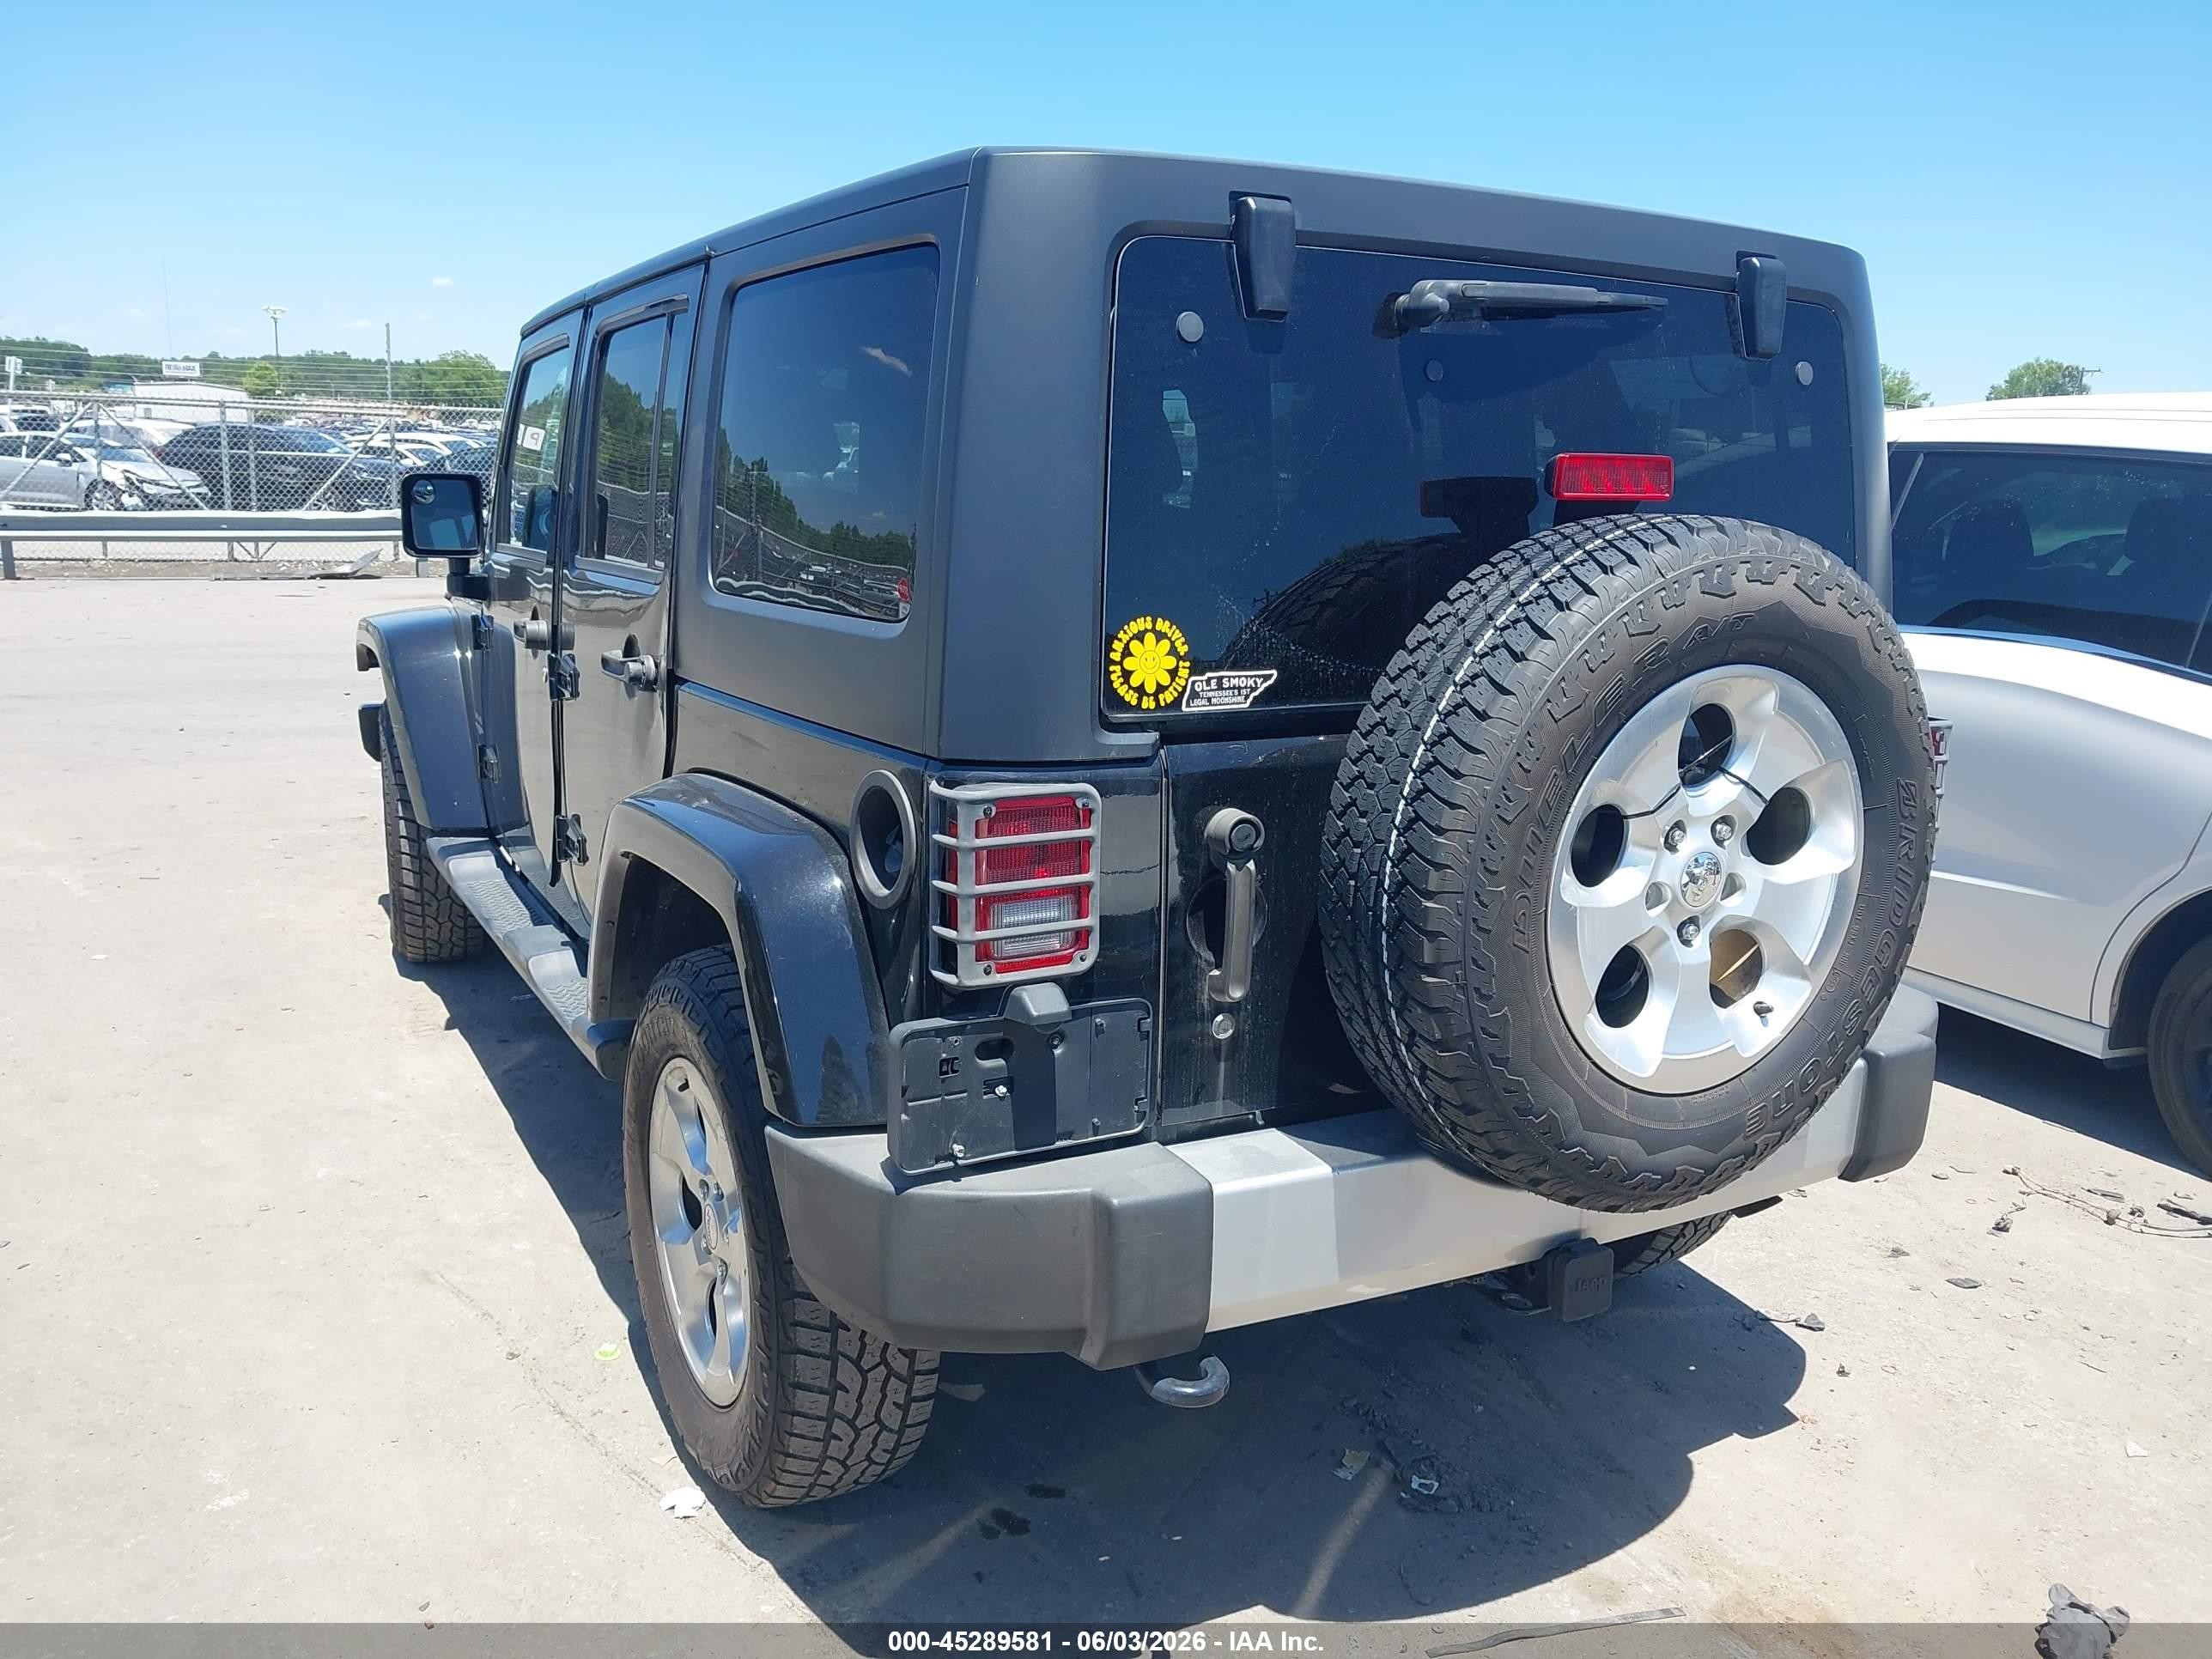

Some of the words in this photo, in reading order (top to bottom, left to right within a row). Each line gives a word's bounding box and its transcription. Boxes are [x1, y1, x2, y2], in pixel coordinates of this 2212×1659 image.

[1109, 616, 1152, 661] ANXIOUS
[1155, 617, 1188, 656] DRIVER
[1109, 665, 1139, 706] PLEASE
[1141, 696, 1156, 709] BE
[1158, 660, 1191, 707] PATIENT
[1194, 678, 1218, 691] OLE
[1222, 677, 1263, 688] SMOKY
[1211, 696, 1246, 704] MOONSHINE
[1744, 776, 1919, 1139] BRIDGESTONE
